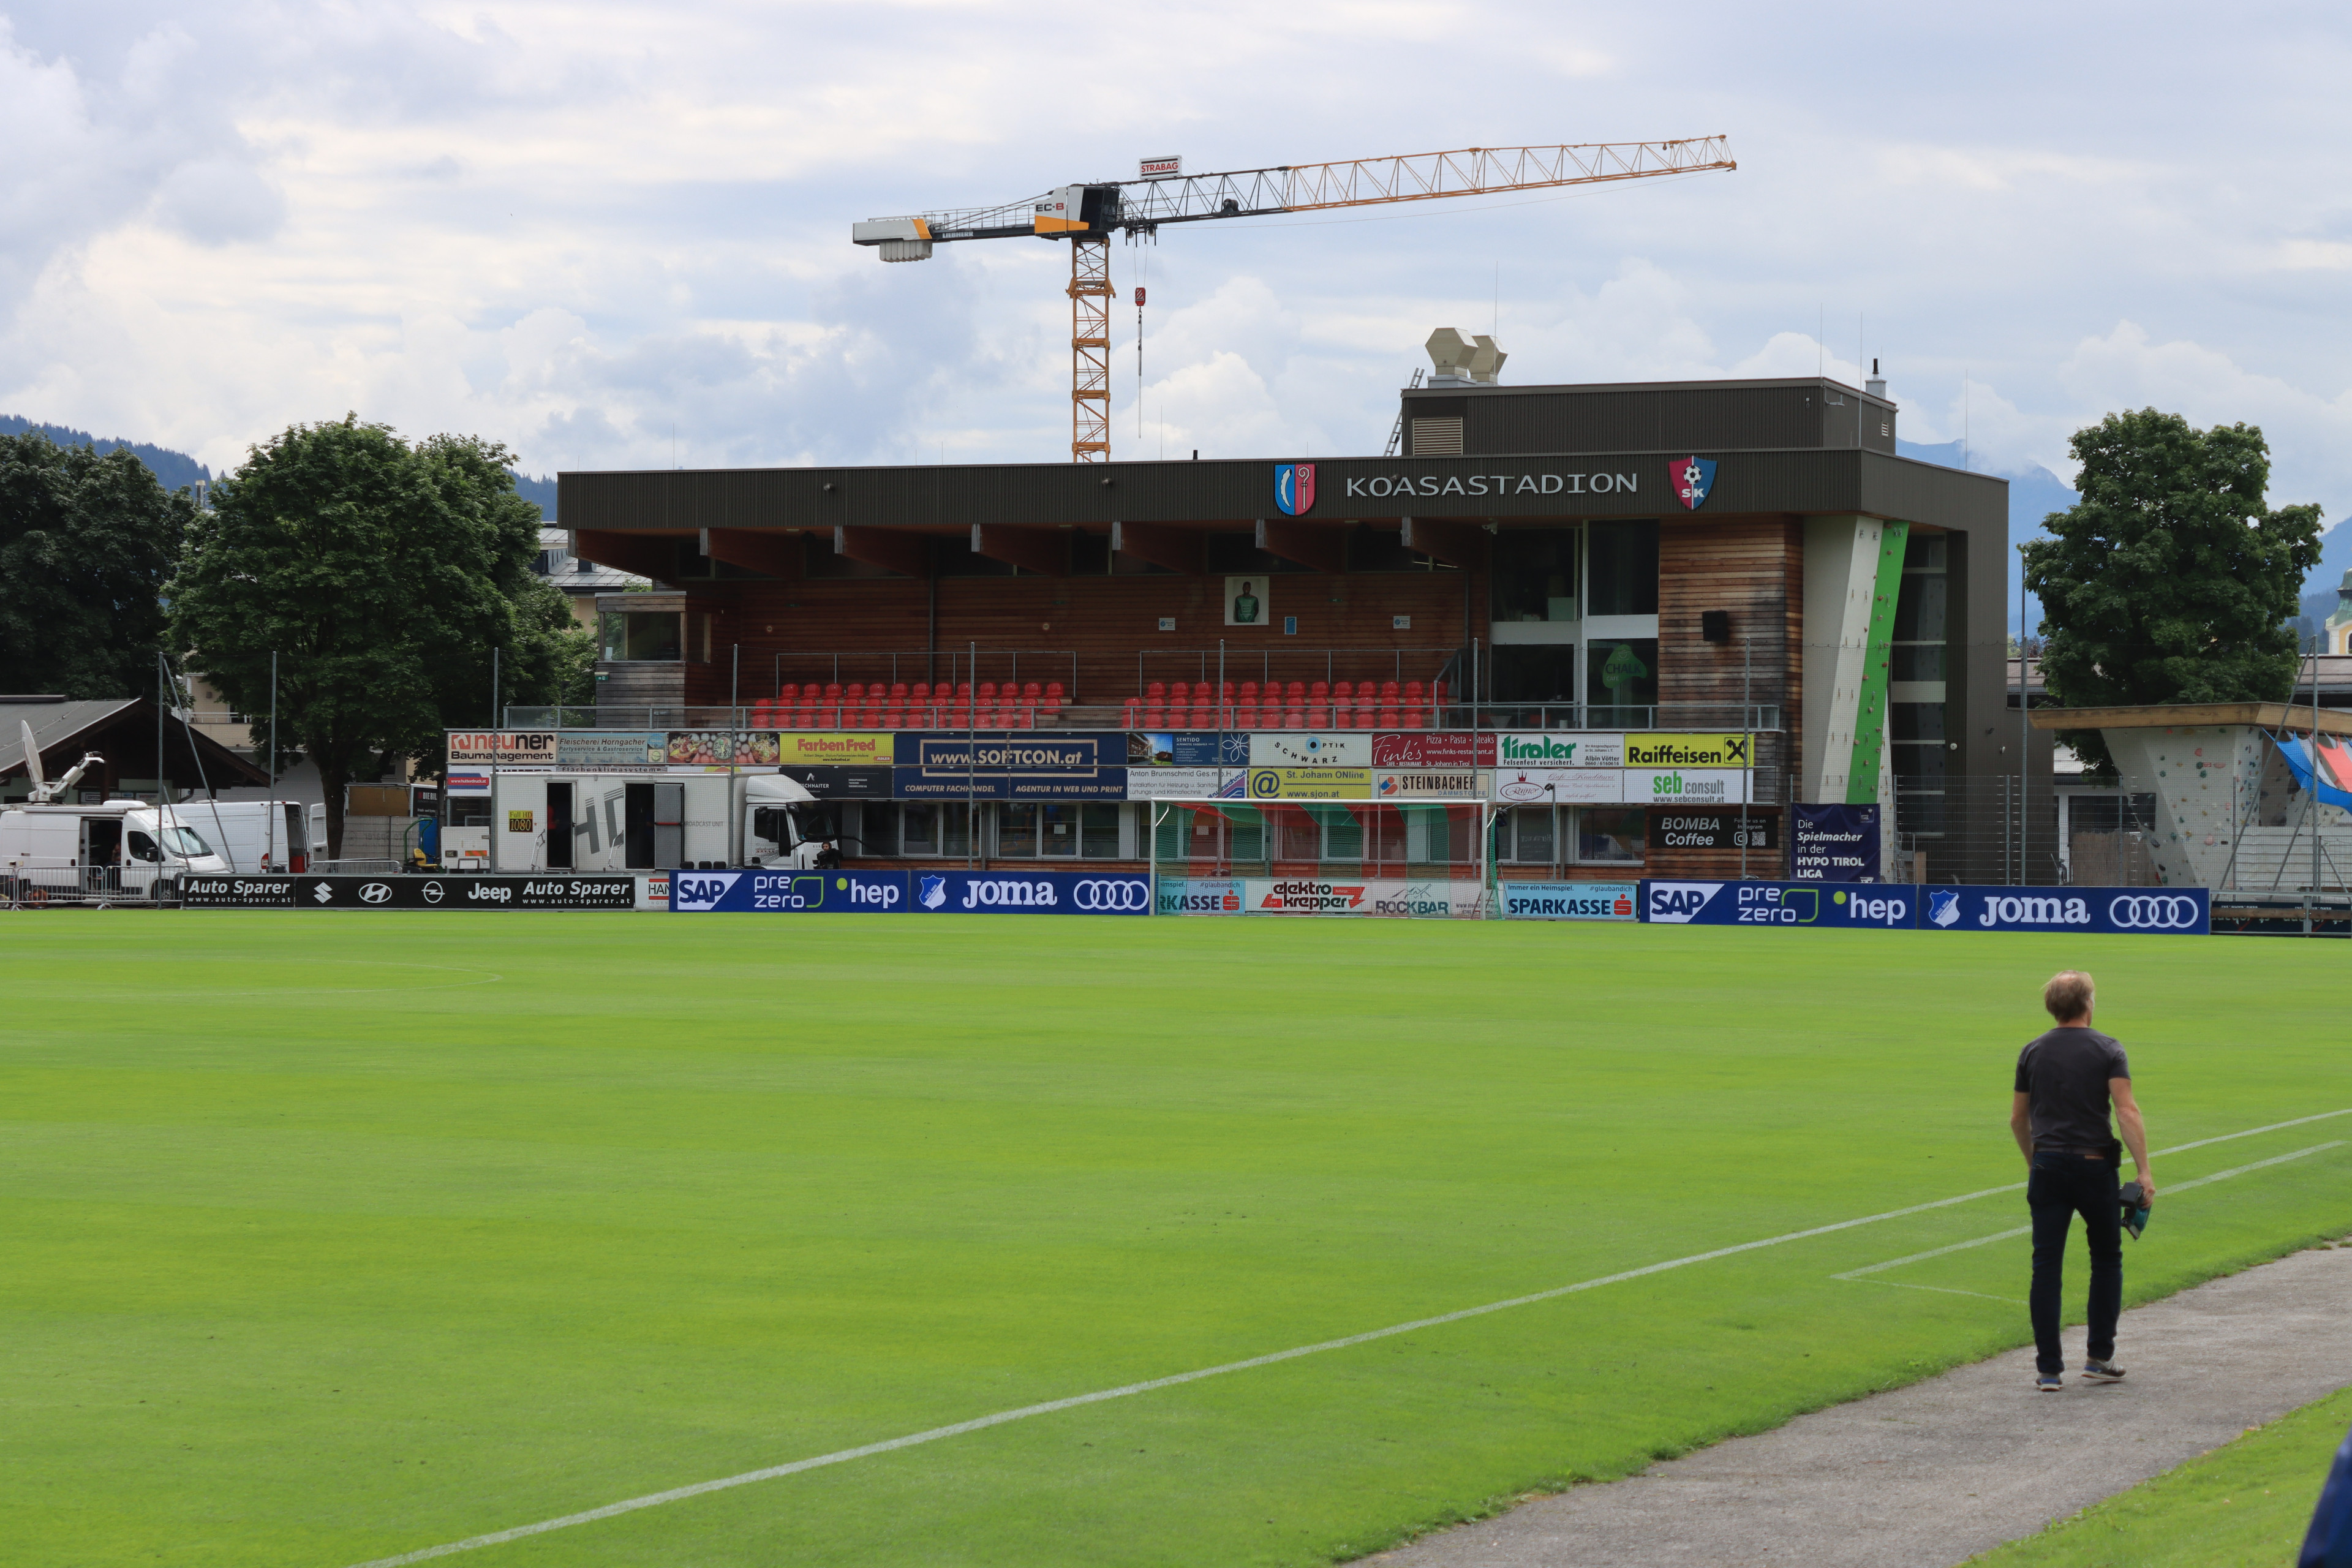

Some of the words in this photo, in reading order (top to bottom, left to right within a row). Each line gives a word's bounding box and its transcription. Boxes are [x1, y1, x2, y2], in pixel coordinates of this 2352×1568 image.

[1141, 162, 1178, 172] STRABAG
[1036, 203, 1064, 212] EC-B
[1348, 473, 1637, 497] KOASASTADION
[1681, 488, 1705, 497] SK
[1605, 663, 1642, 674] CHALK
[475, 734, 554, 750] neuner
[797, 739, 845, 752] Farben
[846, 739, 876, 752] Fred
[1427, 735, 1442, 744] Pizza
[1450, 735, 1466, 744] Pasta
[1502, 735, 1577, 759] tiroler
[931, 750, 1082, 764] www.SOFTCON.at
[1275, 742, 1338, 764] SCHWARZ
[1629, 745, 1722, 763] Raiffeisen
[1653, 771, 1683, 794] seb
[1685, 779, 1725, 794] consult
[1287, 790, 1340, 799] www.sjon.at
[510, 819, 532, 831] 1080
[1662, 817, 1720, 831] BOMBA
[1798, 820, 1814, 829] Die
[1665, 832, 1714, 846] Coffee
[1797, 831, 1863, 843] Spielmacher
[1798, 844, 1806, 853] in
[1810, 844, 1826, 853] der
[1798, 857, 1829, 866] HYPO
[1831, 857, 1865, 867] TIROL
[1797, 869, 1823, 878] LIGA
[189, 880, 228, 894] Auto
[233, 880, 290, 897] Sparer
[523, 881, 564, 895] Auto
[570, 881, 630, 898] Sparer
[679, 879, 725, 903] SAP
[754, 876, 791, 893] pre
[1273, 881, 1332, 895] elektro
[1541, 884, 1574, 893] Heimspiel.
[468, 883, 512, 903] Jeep
[851, 879, 899, 909] hep
[963, 880, 1058, 909] Joma
[1738, 887, 1781, 905] pre
[754, 895, 804, 908] zero
[1283, 894, 1347, 910] krepper
[1376, 900, 1449, 915] ROCKBAR
[1509, 899, 1611, 916] SPARKASSE
[1651, 890, 1705, 915] SAP
[1850, 892, 1905, 925] hep
[1738, 907, 1796, 922] zero
[1980, 896, 2090, 927] Joma
